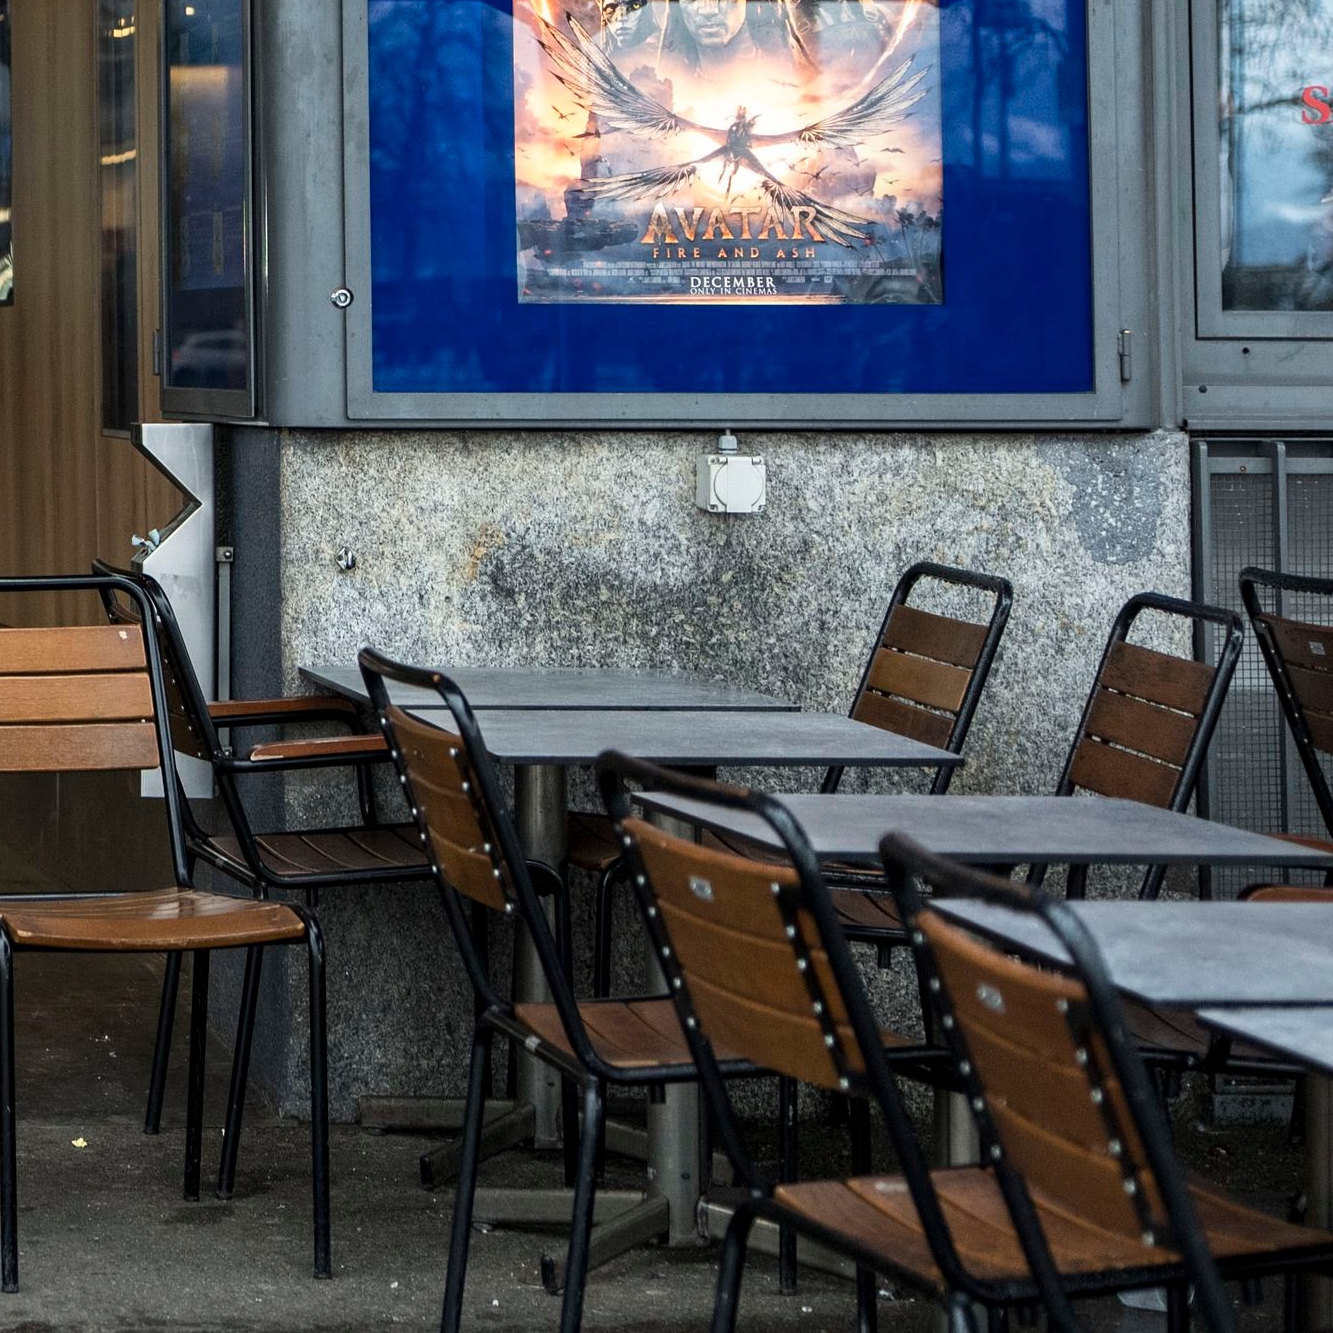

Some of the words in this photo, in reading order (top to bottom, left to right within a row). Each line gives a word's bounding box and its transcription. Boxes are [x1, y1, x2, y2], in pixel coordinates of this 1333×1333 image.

[640, 201, 827, 244] AVATAR
[652, 246, 701, 258] FIRE
[718, 247, 759, 258] AND
[776, 247, 817, 259] ASH
[690, 276, 776, 288] DECEMBER
[690, 287, 717, 295] ONLY
[720, 287, 731, 295] IN
[735, 287, 778, 295] CINEMAS
